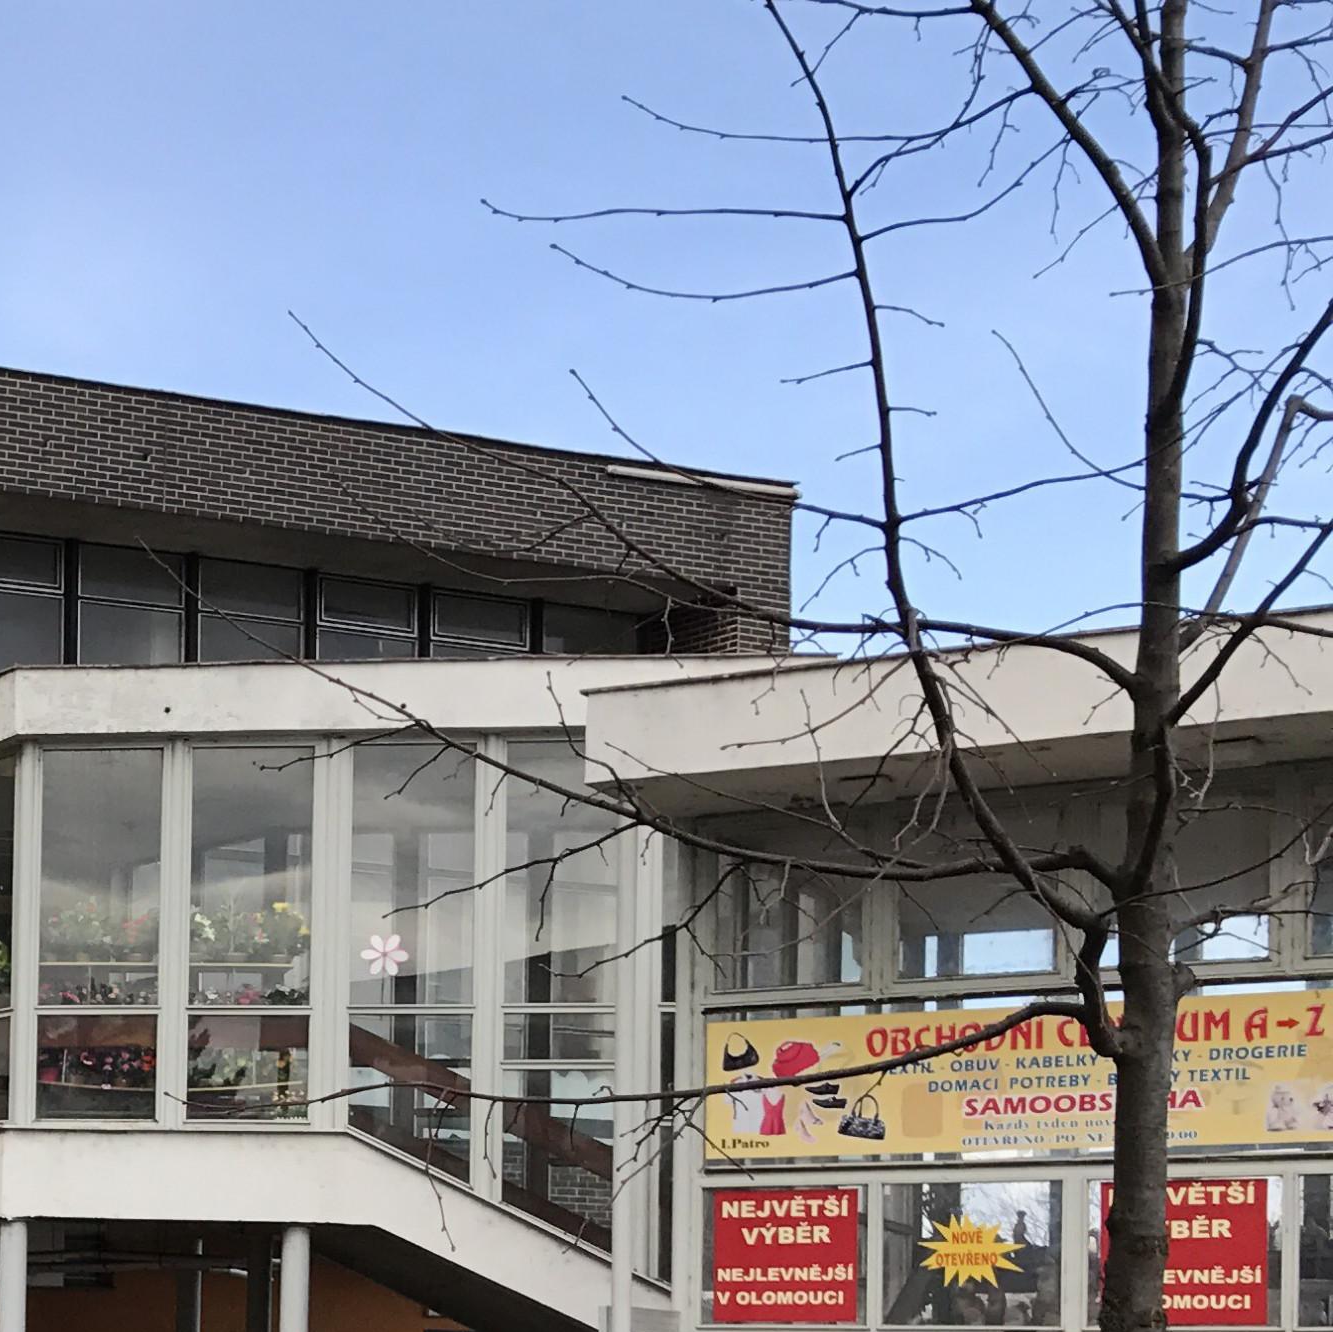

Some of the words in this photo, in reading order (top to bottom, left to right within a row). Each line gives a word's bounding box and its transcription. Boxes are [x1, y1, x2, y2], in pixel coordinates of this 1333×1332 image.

[1245, 1006, 1268, 1042] A
[950, 1058, 999, 1073] OBUV
[1016, 1053, 1099, 1070] KABELKY
[1209, 1044, 1308, 1061] DROGERIE
[1189, 1068, 1251, 1082] TEXTIL
[721, 1195, 849, 1219] NEJVĚTŠÍ
[741, 1222, 831, 1245] VÝBĚR
[936, 1251, 998, 1267] OTEVŘENO
[717, 1264, 853, 1282] NEJLEVNĚJŠÍ
[717, 1292, 731, 1305] V
[736, 1291, 844, 1305] OLOMOUCI
